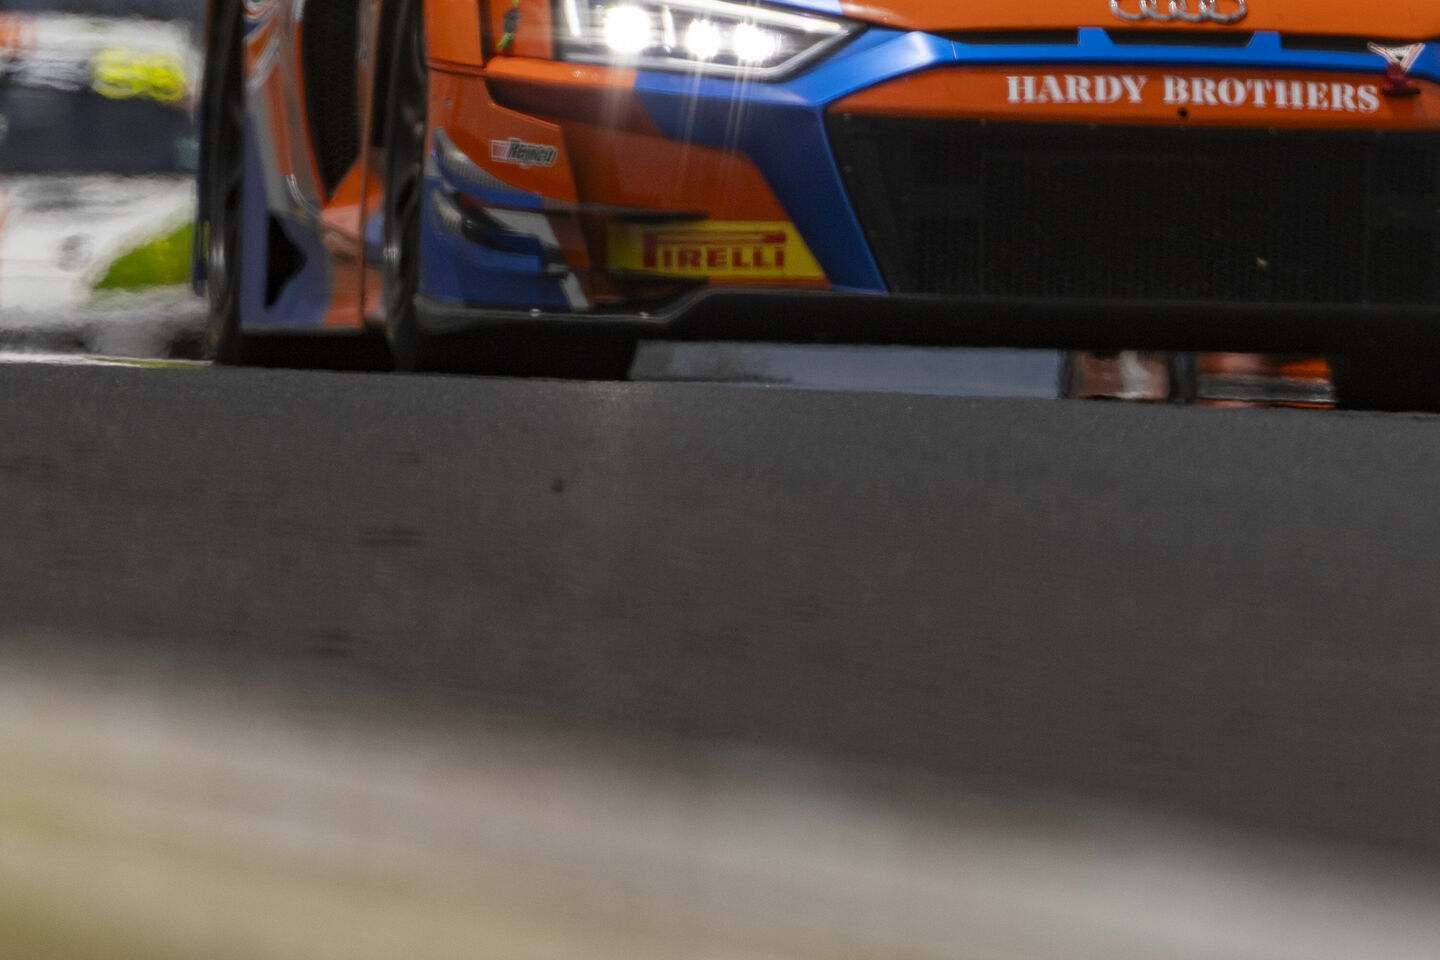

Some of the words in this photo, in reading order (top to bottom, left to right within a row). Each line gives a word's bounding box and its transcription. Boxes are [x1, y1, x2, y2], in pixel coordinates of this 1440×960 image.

[1006, 74, 1147, 104] HARDY
[1162, 74, 1381, 113] BROTHERS
[642, 230, 787, 269] PIRELLI
